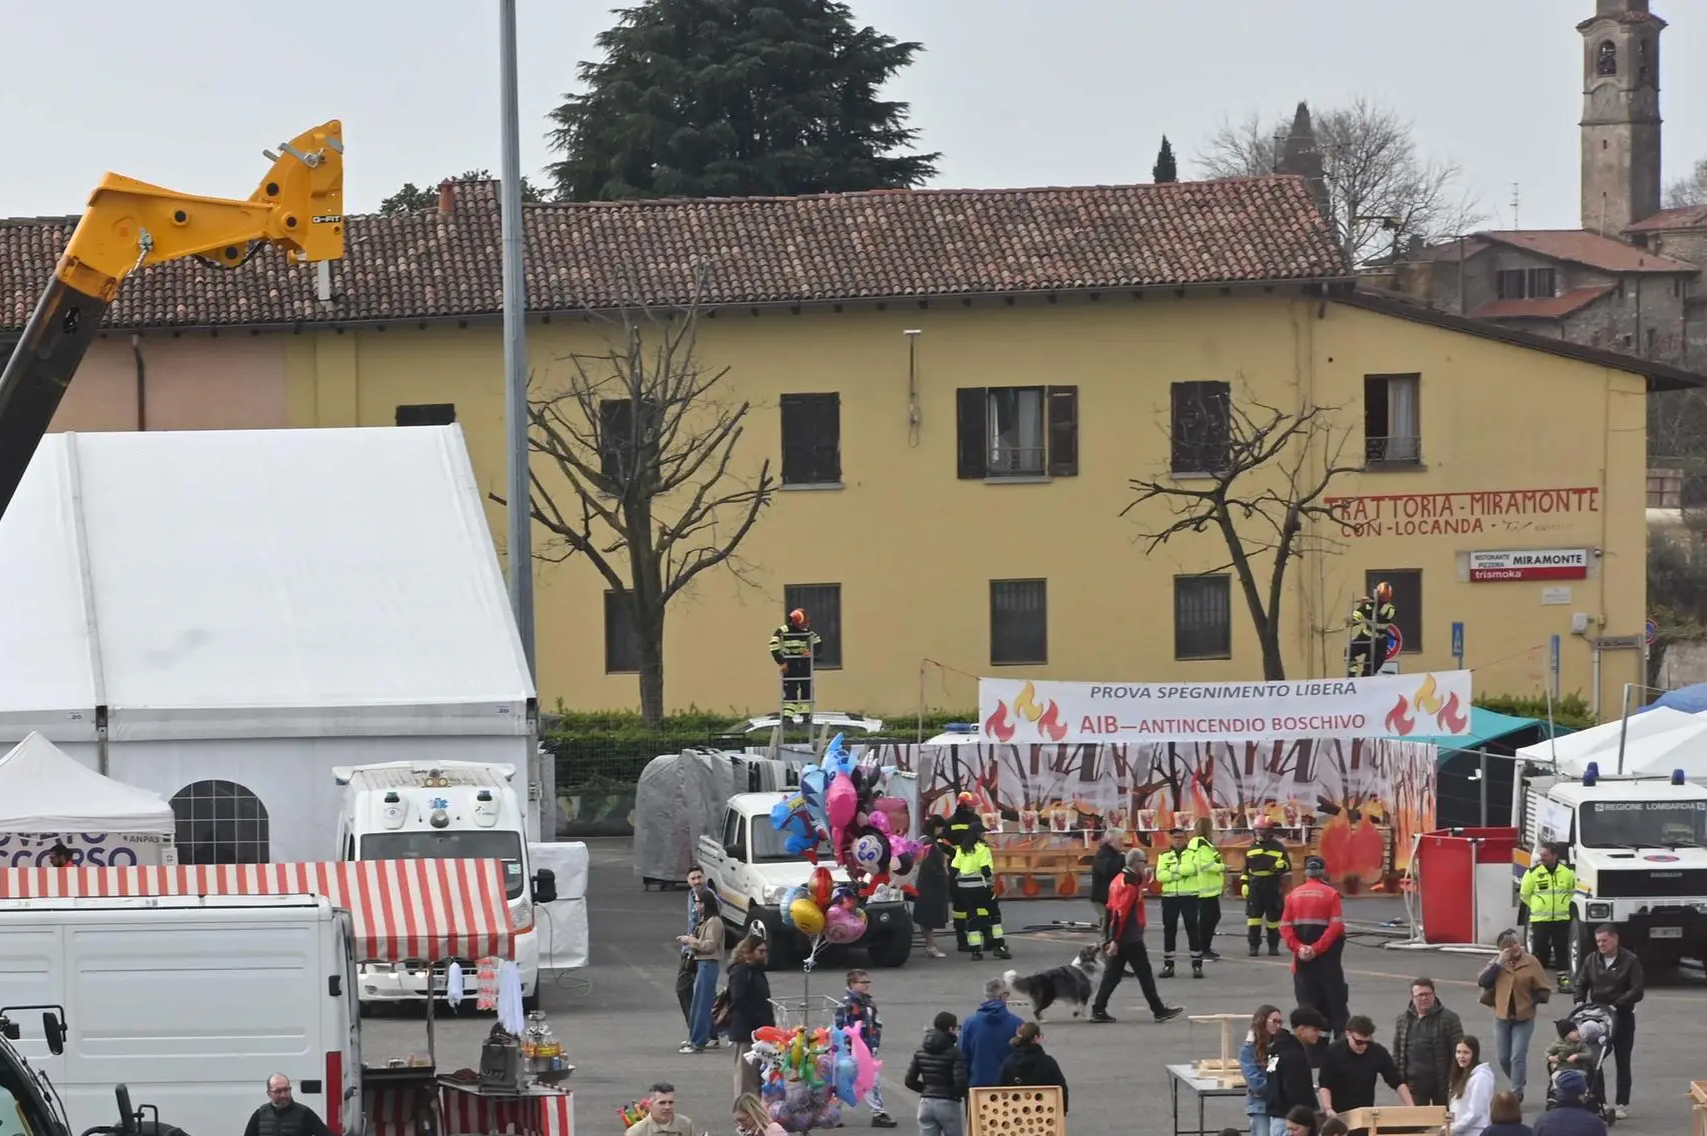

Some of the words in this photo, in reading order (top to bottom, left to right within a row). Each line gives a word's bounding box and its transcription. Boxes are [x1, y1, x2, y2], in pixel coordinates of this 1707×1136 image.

[1324, 494, 1454, 521] TRATTORIA
[1470, 488, 1599, 515] MIRAMONTE
[1342, 520, 1382, 537] CON
[1395, 518, 1484, 536] LOCANDA
[1513, 554, 1583, 566] MIRAMONTE
[1475, 570, 1522, 579] trismoka
[1090, 686, 1151, 699] PROVA
[1157, 684, 1290, 699] SPEGNIMENTO
[1295, 682, 1357, 697] LIBERA
[1272, 714, 1366, 731] BOSCHIVO
[1605, 803, 1643, 811] REGIONE
[1646, 803, 1696, 811] LOMBARDIA
